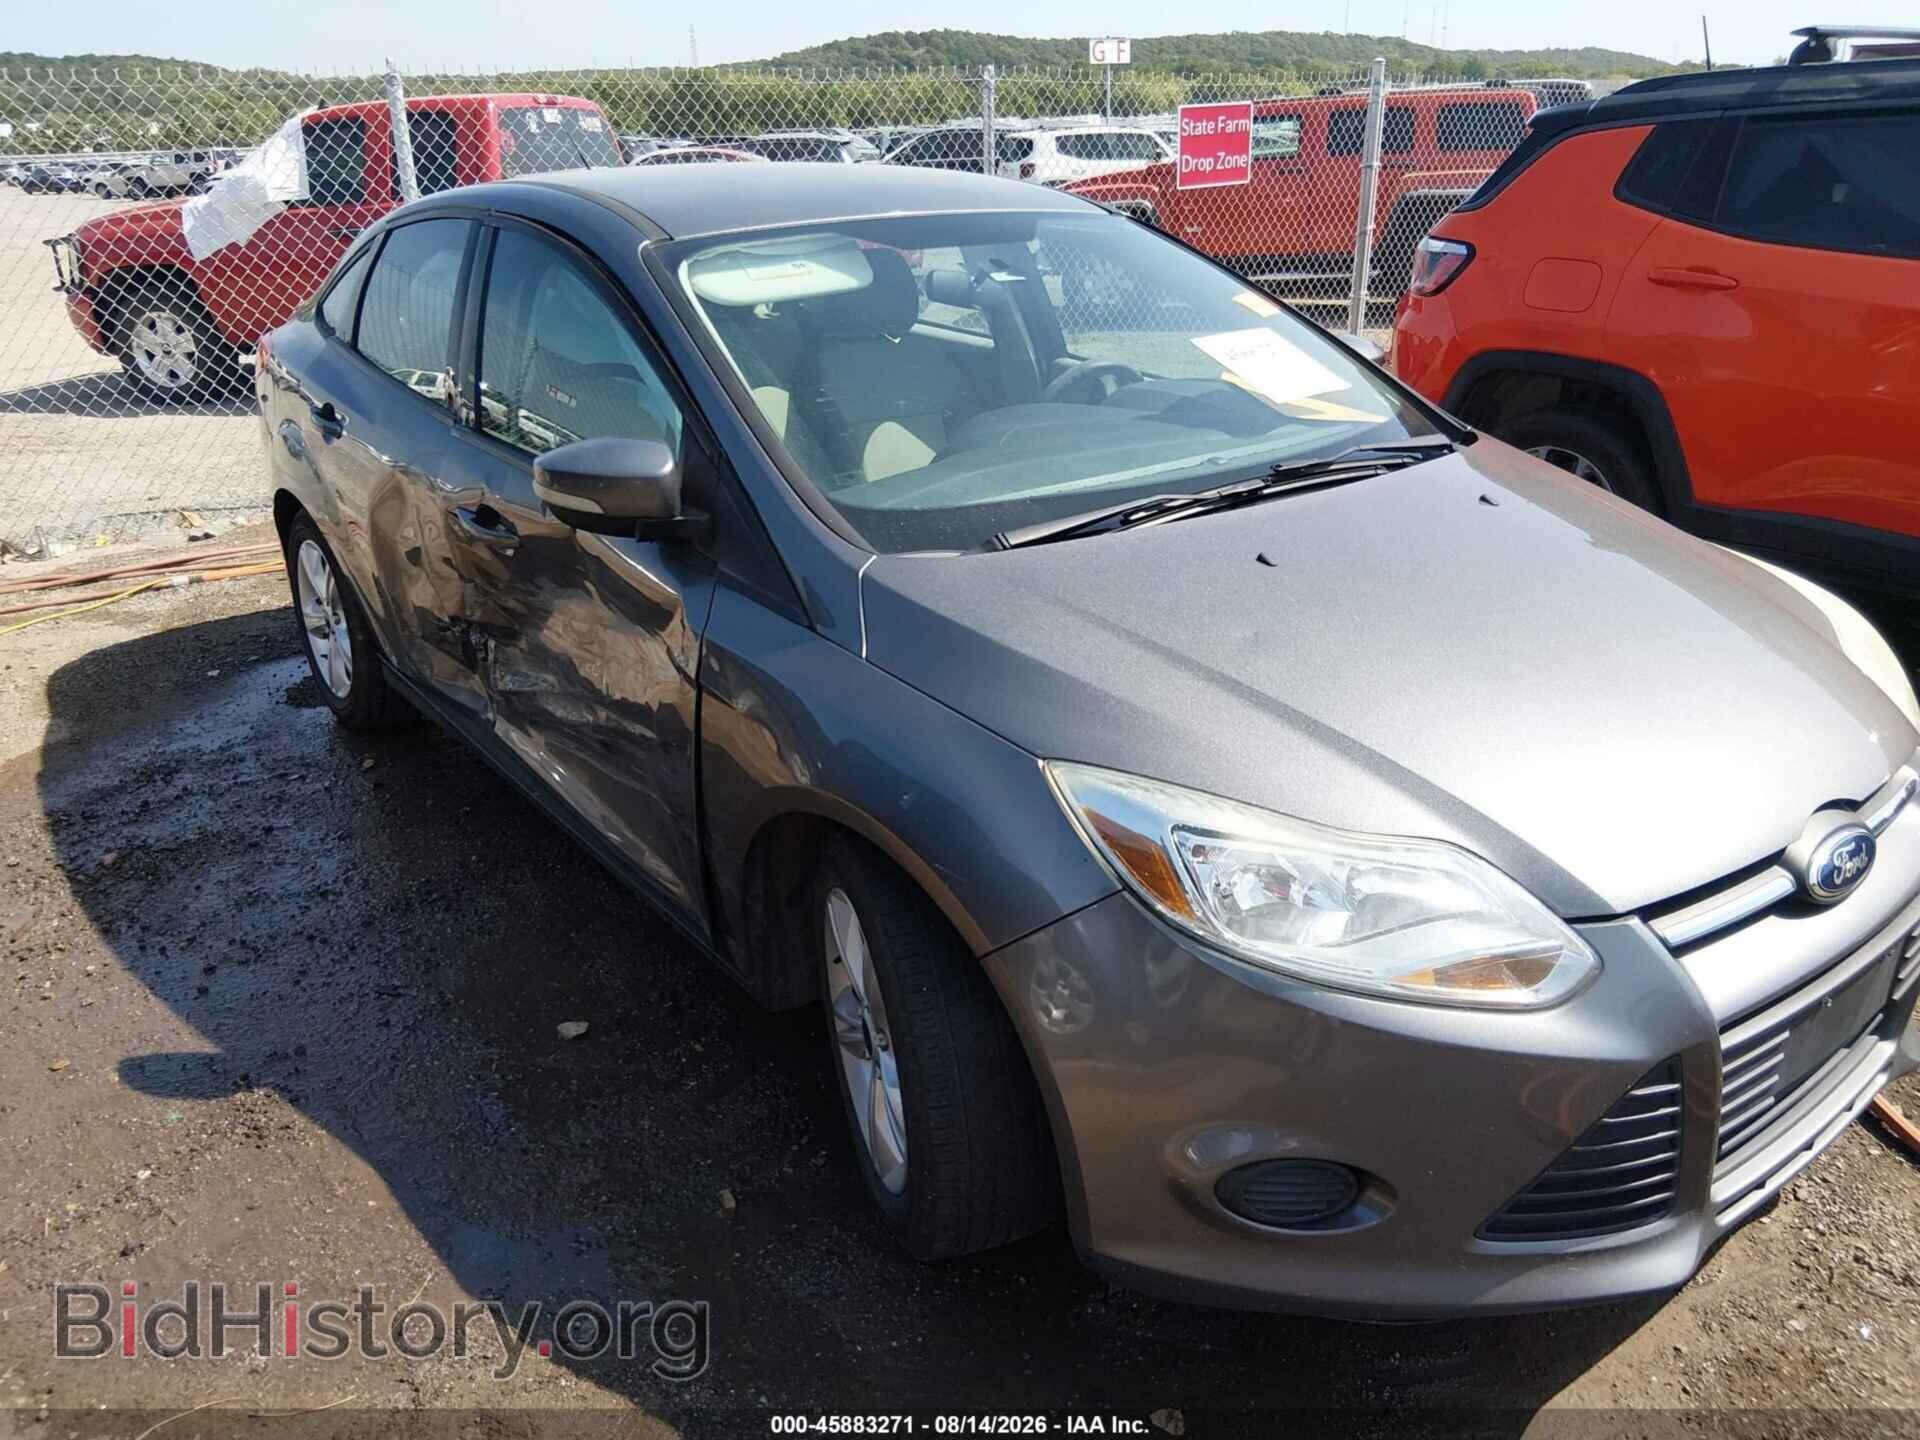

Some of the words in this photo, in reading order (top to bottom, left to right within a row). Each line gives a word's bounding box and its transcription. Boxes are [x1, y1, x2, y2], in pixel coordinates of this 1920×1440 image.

[1092, 40, 1105, 62] G
[1116, 40, 1126, 64] F
[1181, 117, 1215, 137] State
[1217, 115, 1250, 134] Farm
[1181, 154, 1214, 174] Drop
[1216, 151, 1248, 170] Zone
[1832, 841, 1869, 885] Ford
